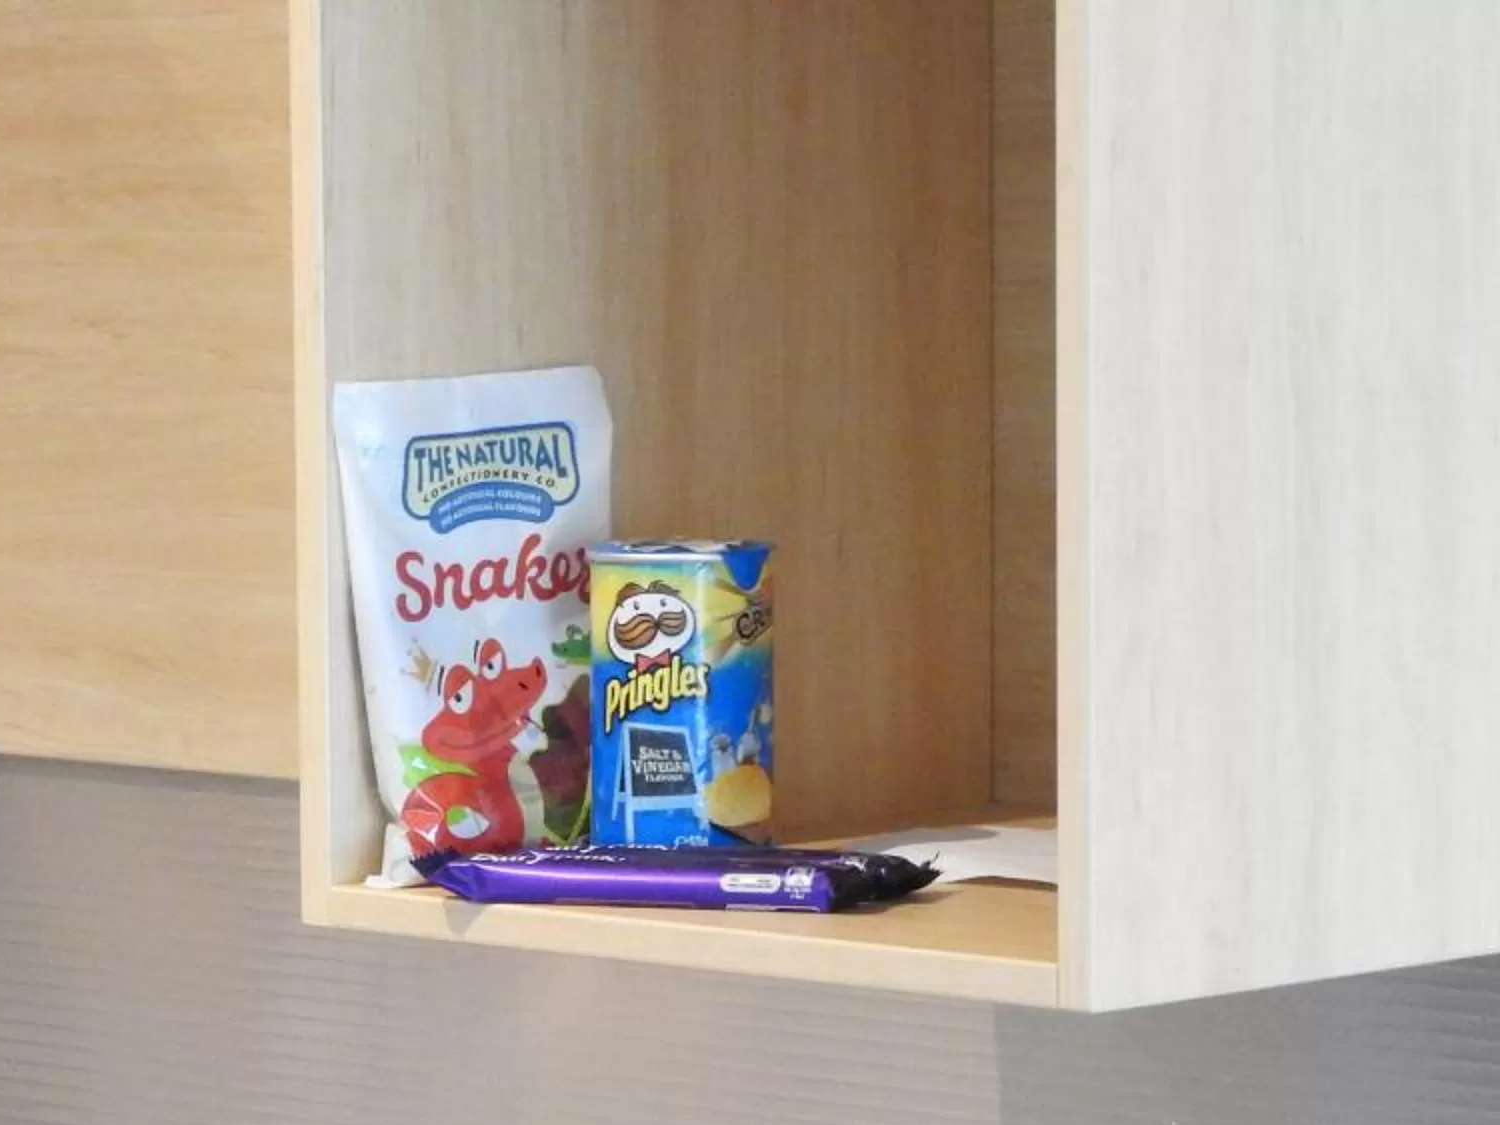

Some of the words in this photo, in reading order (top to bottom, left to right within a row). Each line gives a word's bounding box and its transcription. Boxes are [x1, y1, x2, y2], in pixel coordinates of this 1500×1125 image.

[413, 446, 454, 492] THE
[455, 434, 568, 478] NATURAL
[423, 468, 529, 503] CONFECTIONERY
[604, 655, 710, 734] Pringles
[631, 760, 692, 774] VINEGAR
[639, 746, 670, 761] SALT
